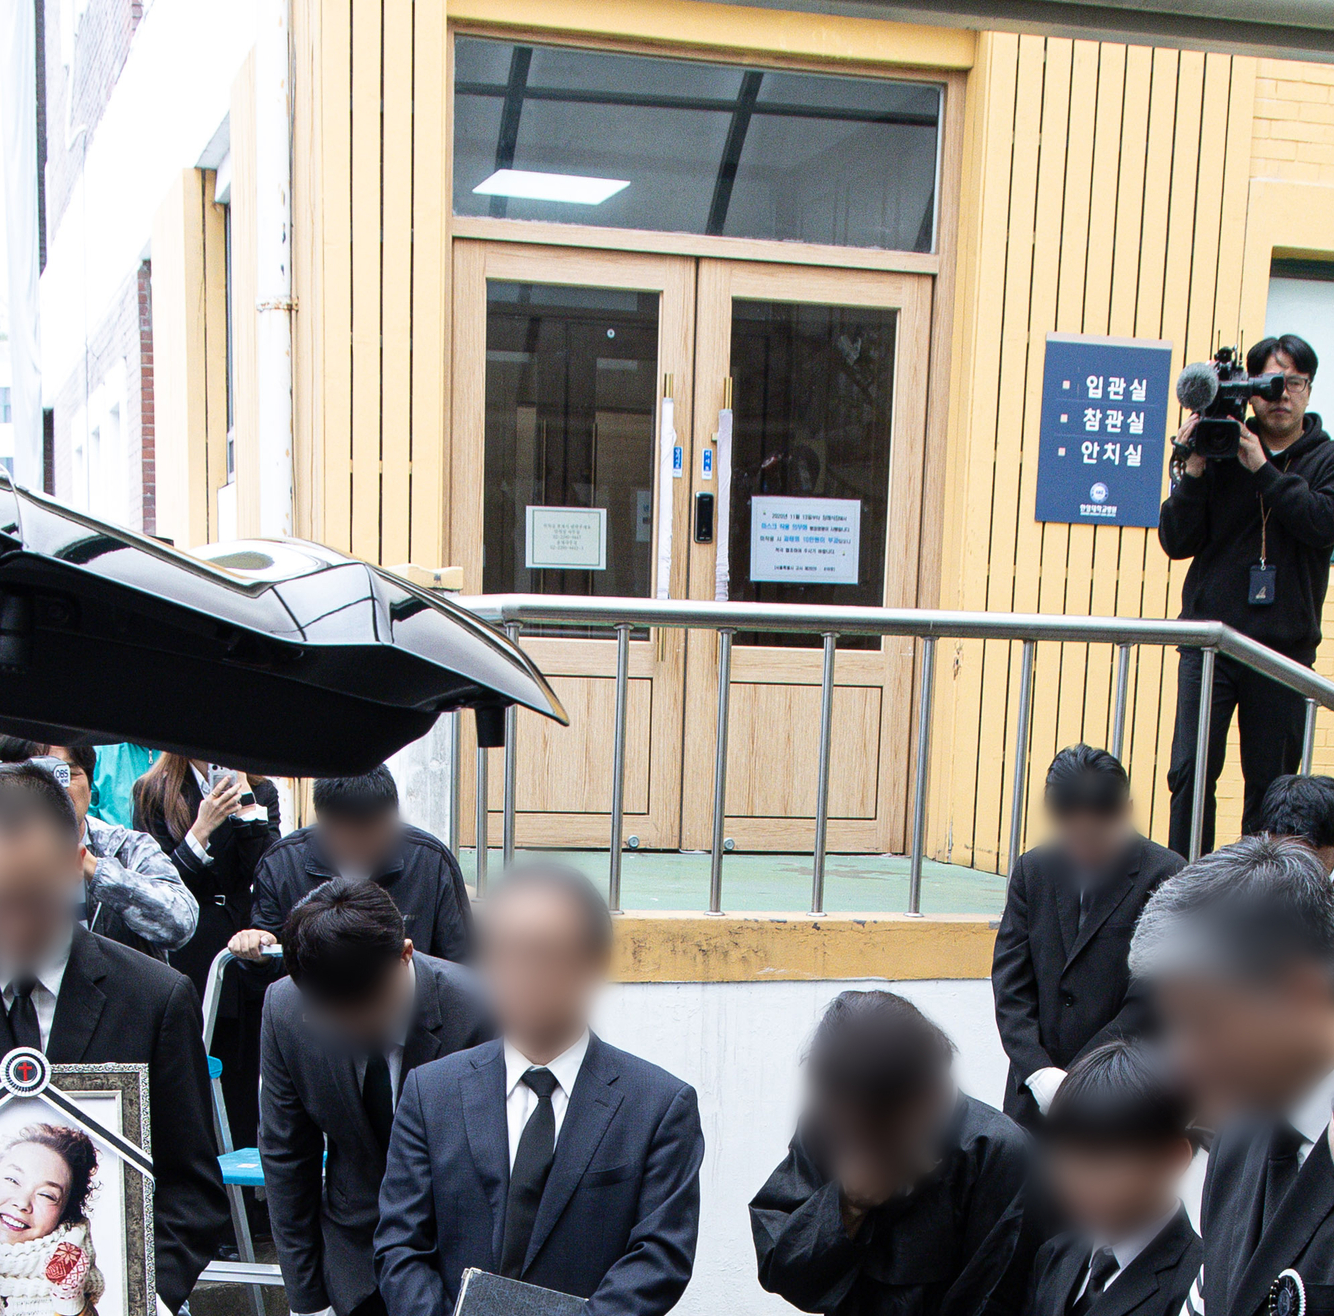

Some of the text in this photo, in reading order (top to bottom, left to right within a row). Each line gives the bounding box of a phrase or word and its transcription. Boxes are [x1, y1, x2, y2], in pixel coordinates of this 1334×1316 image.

[1086, 375, 1147, 402] 입관실
[1083, 408, 1145, 435] 참관실
[1080, 440, 1143, 467] 안치실
[56, 769, 68, 778] OBS
